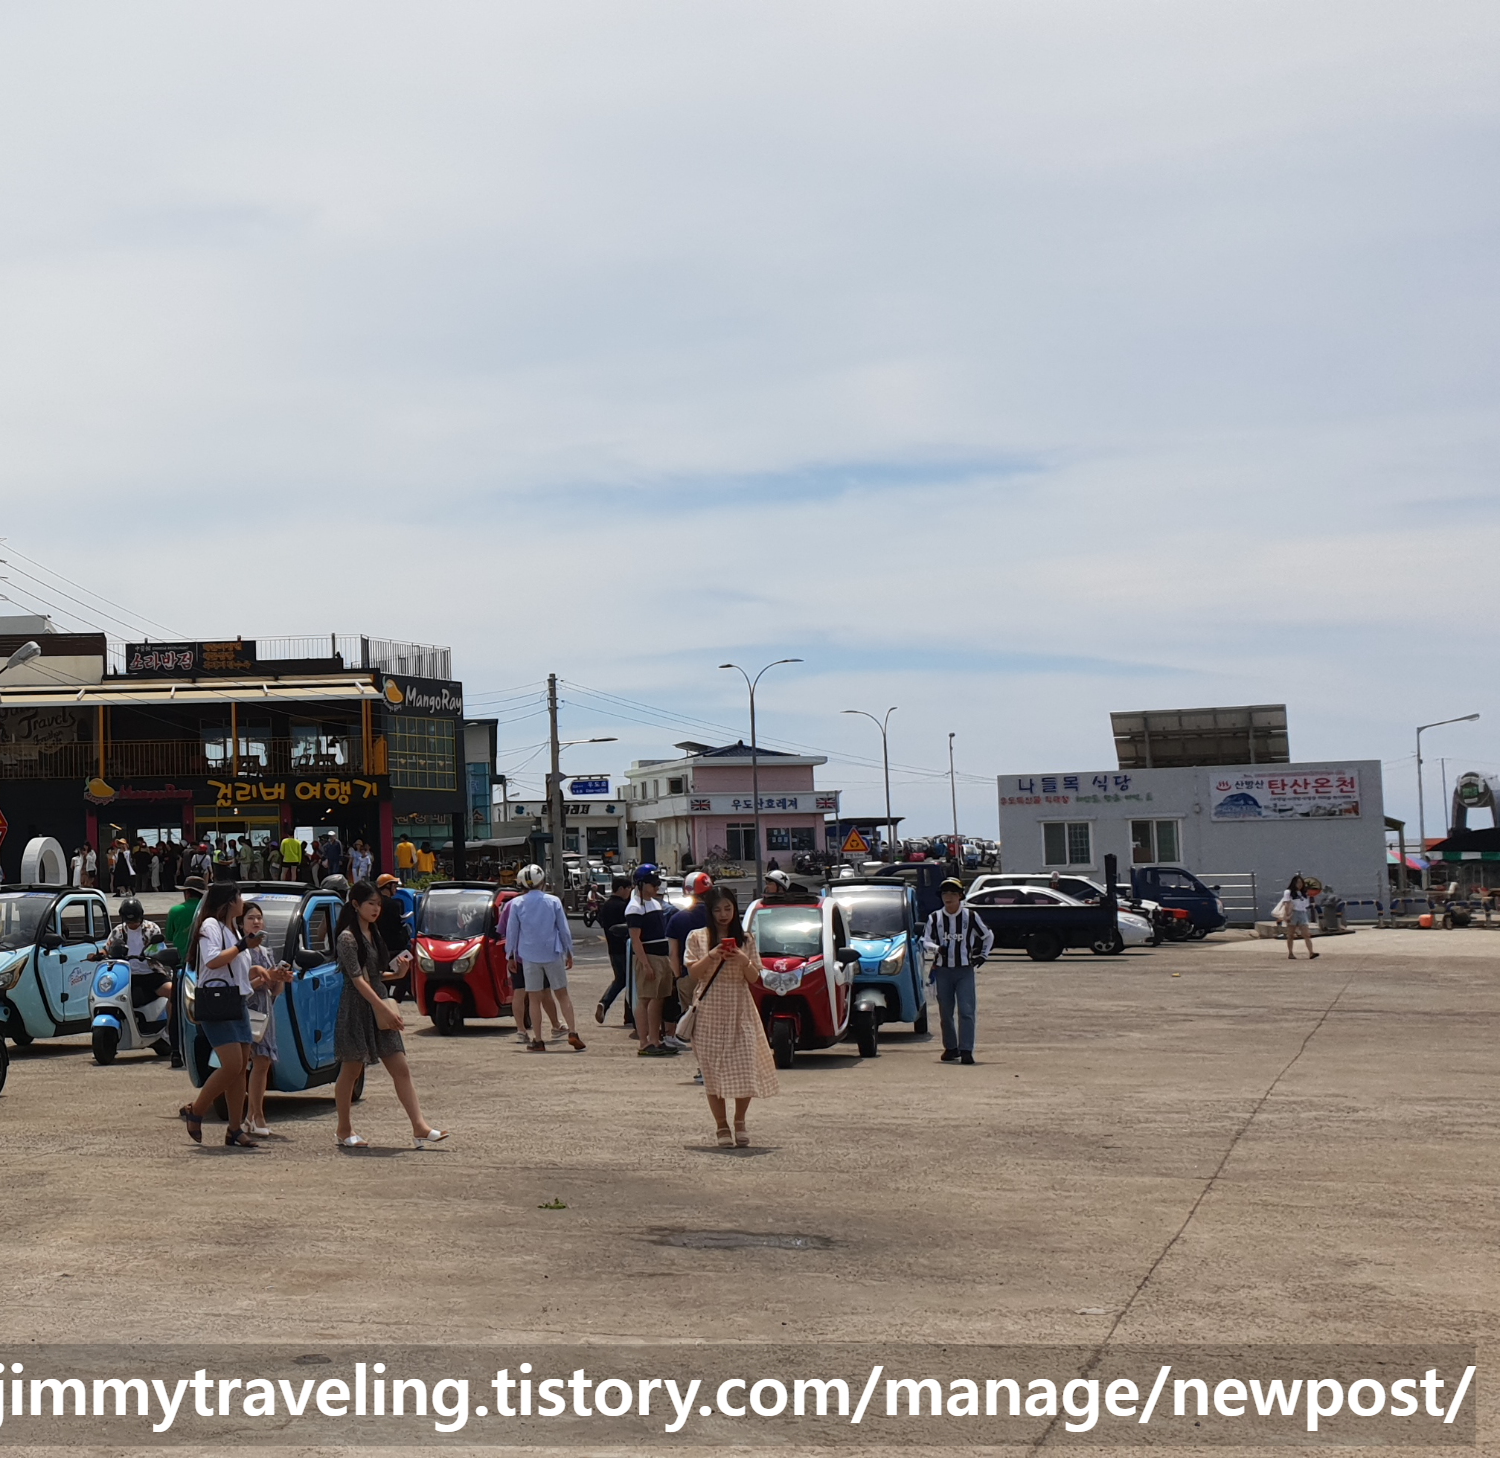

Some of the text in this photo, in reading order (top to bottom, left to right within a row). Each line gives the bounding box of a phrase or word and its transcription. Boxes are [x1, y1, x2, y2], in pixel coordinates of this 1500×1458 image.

[405, 684, 462, 716] MangoRay
[207, 777, 378, 807] 걸리버 여행기
[1018, 774, 1131, 794] 나들목 식당
[1267, 777, 1356, 796] 탄산온천
[942, 931, 964, 942] Jeep
